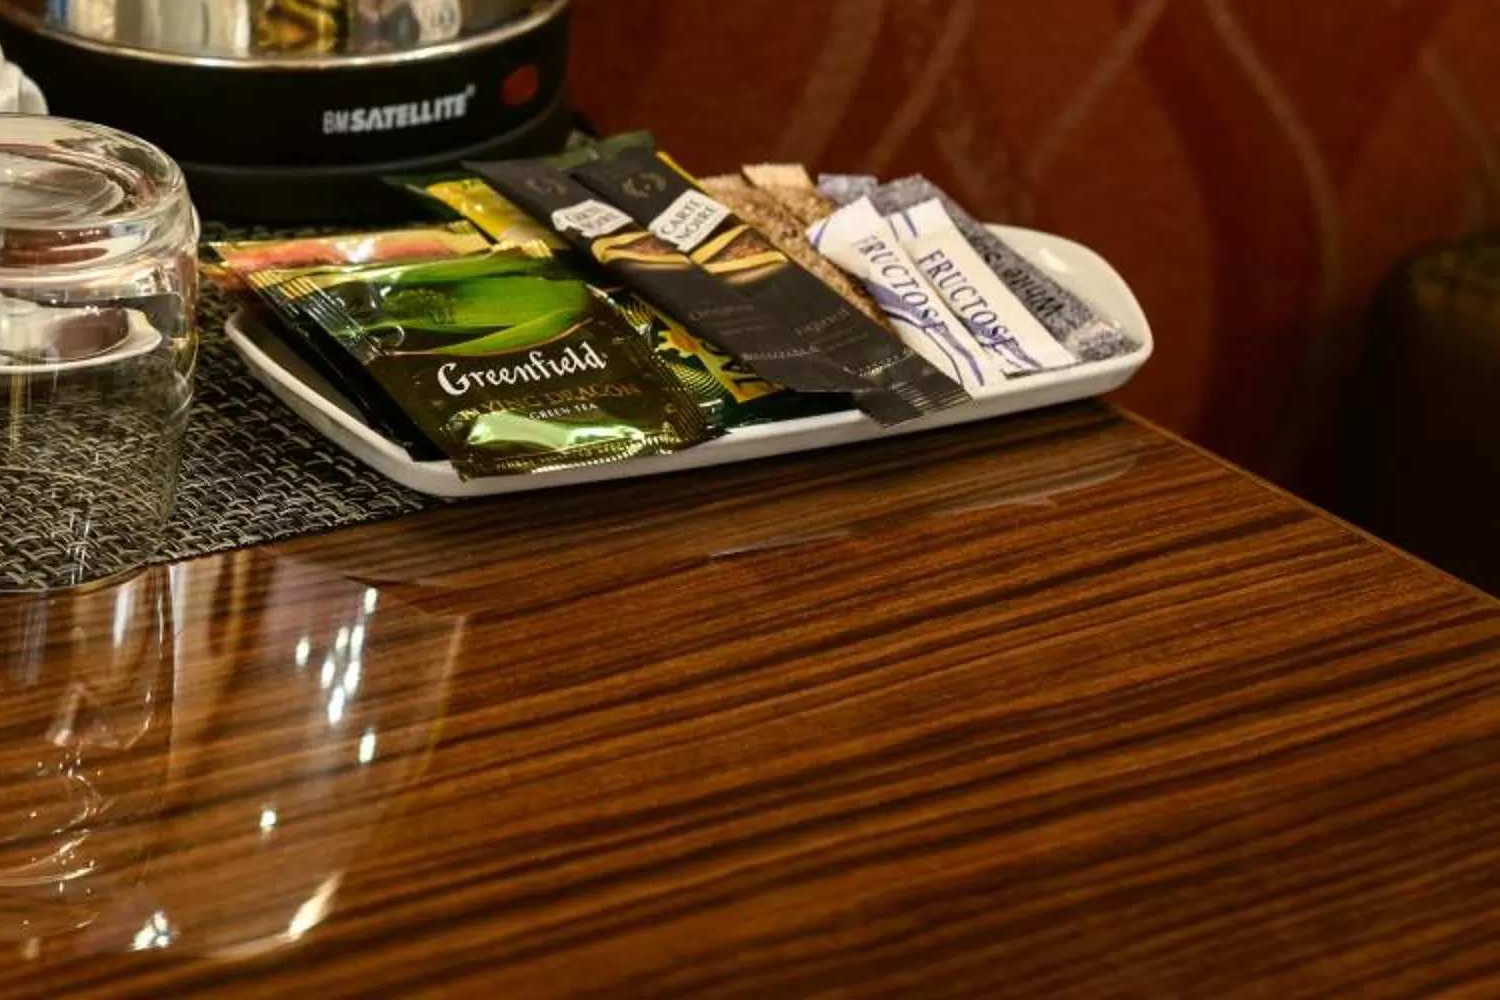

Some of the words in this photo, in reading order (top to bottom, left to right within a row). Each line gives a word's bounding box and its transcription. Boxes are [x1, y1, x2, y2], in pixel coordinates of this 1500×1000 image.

[660, 198, 704, 236] CARTE
[851, 234, 950, 336] FRUCTOSE
[917, 249, 1021, 351] FRUCTOSE
[437, 341, 607, 397] Greenfield
[529, 407, 570, 420] GREEN
[574, 402, 600, 415] TEA
